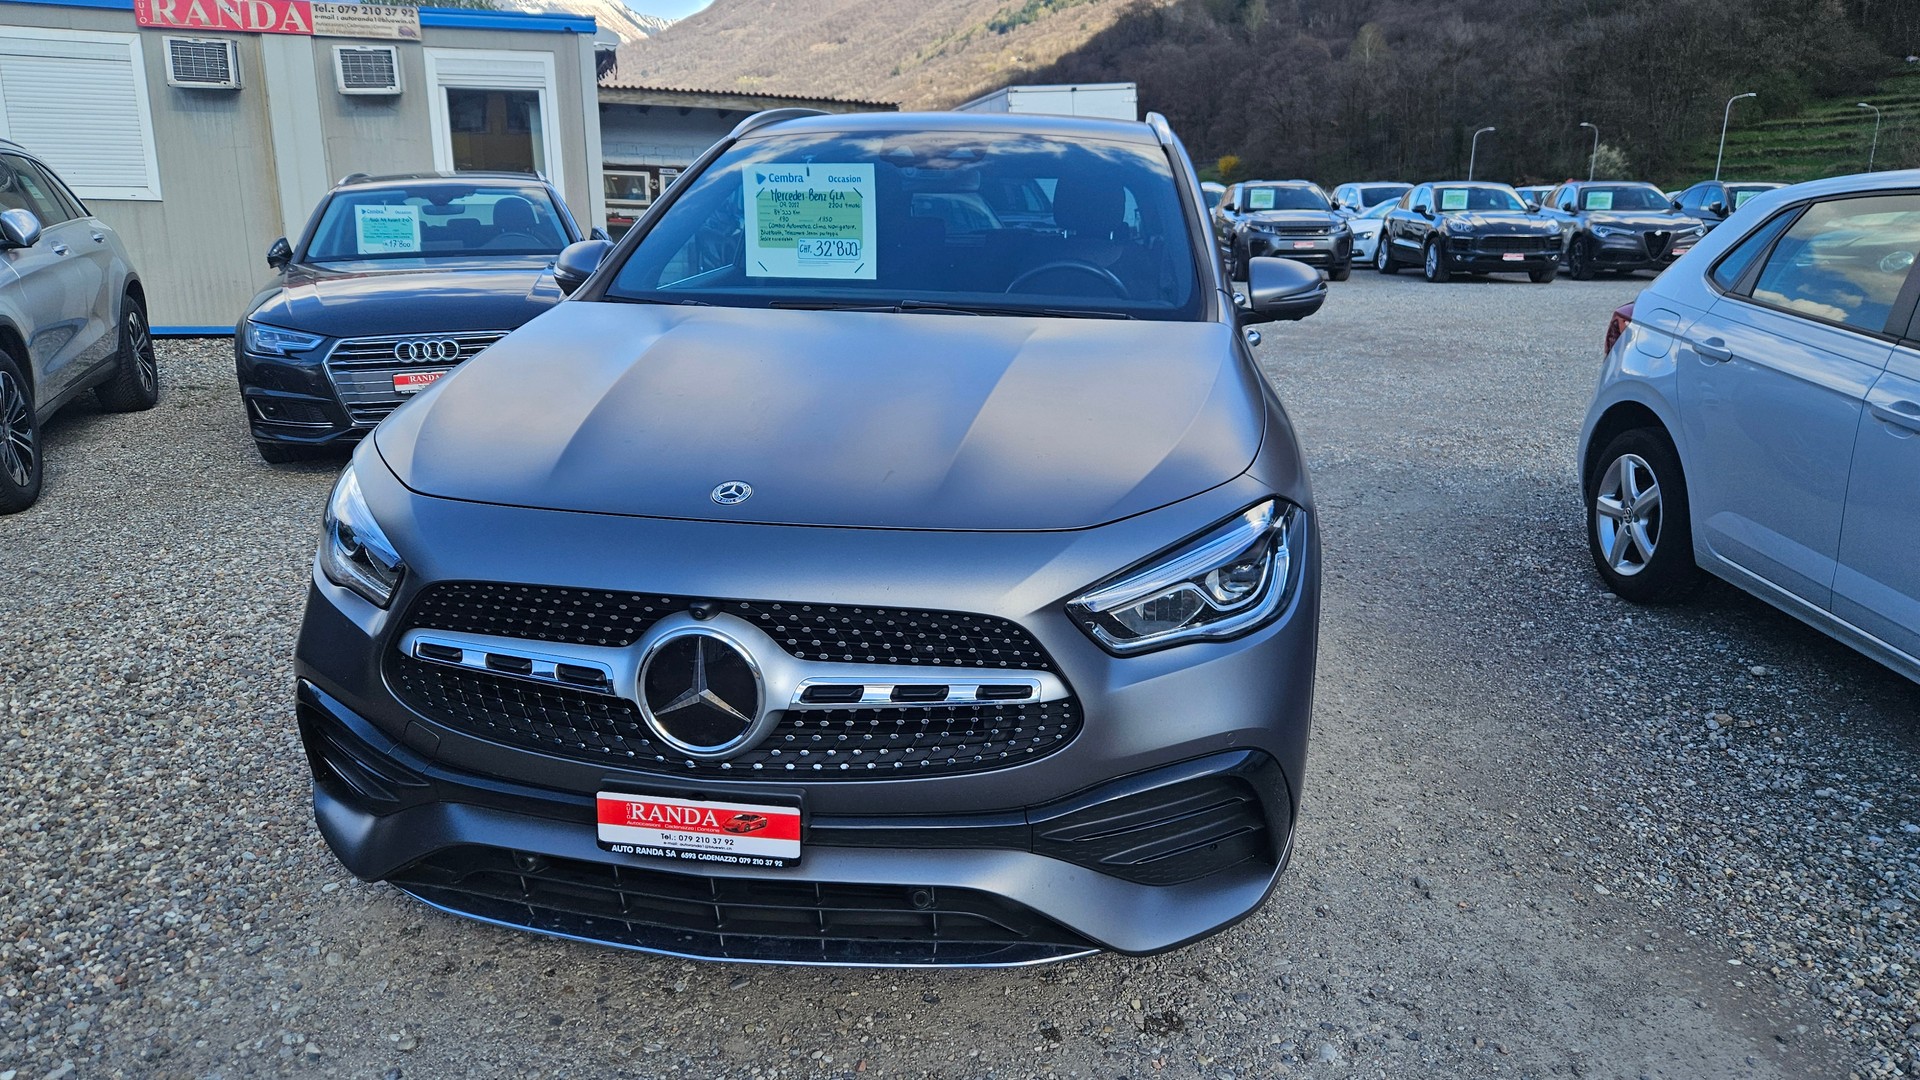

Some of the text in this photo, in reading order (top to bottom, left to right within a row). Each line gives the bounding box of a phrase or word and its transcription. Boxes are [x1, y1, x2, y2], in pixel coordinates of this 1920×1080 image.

[150, 0, 311, 32] RANDA
[313, 4, 415, 18] Tel.: 079 210 37 92
[768, 173, 862, 183] Cembra Occasion
[829, 189, 846, 204] GLA
[813, 240, 858, 257] 32'800
[409, 374, 440, 383] RANDA
[631, 803, 720, 827] RANDA
[661, 833, 734, 846] Tel.: 079 210 37 92
[611, 844, 783, 868] AUTO RANDA SA 6593 CADENAZZO 079 210 37 92
